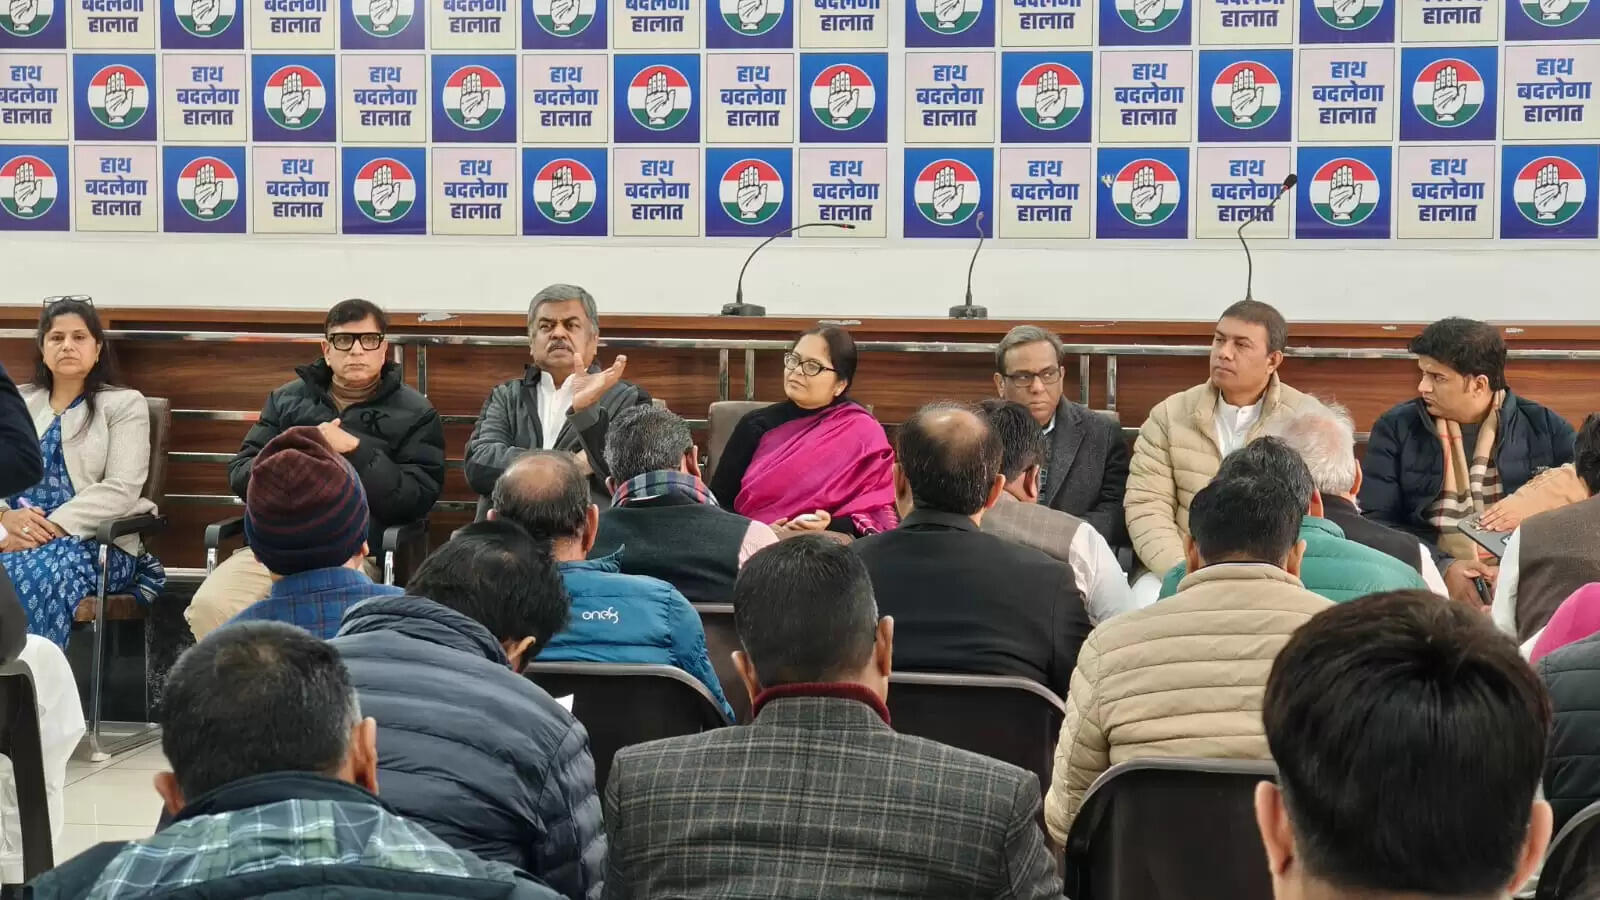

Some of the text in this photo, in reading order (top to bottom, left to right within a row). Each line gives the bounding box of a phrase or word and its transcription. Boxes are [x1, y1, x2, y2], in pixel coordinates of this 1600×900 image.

[631, 16, 684, 32] हालात
[820, 14, 875, 31] हालात
[1019, 13, 1075, 30] हालात
[1220, 10, 1279, 28] हालात
[1422, 7, 1482, 25] हालात
[89, 18, 138, 33] हालात
[271, 17, 321, 33] हालात
[449, 17, 501, 33] हालात
[9, 65, 42, 82] हाथ
[192, 66, 224, 82] हाथ
[369, 66, 401, 83] हाथ
[549, 66, 583, 83] हाथ
[737, 65, 771, 82] हाथ
[932, 64, 968, 82] हाथ
[1131, 63, 1168, 80] हाथ
[1330, 61, 1368, 79] हाथ
[1535, 58, 1575, 76] हाथ
[0, 84, 58, 104] बदलेगा
[176, 84, 240, 105] बदलेगा
[353, 84, 418, 105] बदलेगा
[533, 84, 599, 106] बदलेगा
[719, 83, 787, 106] बदलेगा
[916, 83, 985, 105] बदलेगा
[1113, 81, 1185, 104] बदलेगा
[1311, 80, 1385, 102] बदलेगा
[1516, 77, 1593, 100] बदलेगा
[1, 109, 53, 124] हालात
[183, 109, 234, 125] हालात
[360, 110, 411, 126] हालात
[540, 110, 592, 127] हालात
[726, 110, 780, 126] हालात
[922, 109, 977, 126] हालात
[1120, 108, 1178, 126] हालात
[1318, 107, 1377, 124] हालात
[1523, 104, 1584, 122] हालात
[100, 157, 132, 174] हाथ
[281, 159, 314, 175] हाथ
[459, 159, 493, 176] हाथ
[640, 160, 675, 177] हाथ
[829, 160, 863, 177] हाथ
[1027, 160, 1063, 177] हाथ
[1229, 159, 1266, 177] हाथ
[1429, 158, 1467, 176] हाथ
[85, 175, 148, 196] बदलेगा
[265, 177, 329, 197] बदलेगा
[443, 178, 508, 199] बदलेगा
[624, 178, 691, 199] बदलेगा
[812, 178, 880, 200] बदलेगा
[1010, 178, 1080, 201] बदलेगा
[1210, 178, 1283, 201] बदलेगा
[1411, 177, 1485, 200] बदलेगा
[91, 200, 141, 216] हालात
[273, 202, 323, 218] हालात
[450, 203, 502, 219] हालात
[631, 203, 684, 220] हालात
[818, 204, 873, 221] हालात
[1016, 205, 1073, 222] हालात
[1217, 205, 1275, 222] हालात
[1418, 204, 1478, 222] हालात
